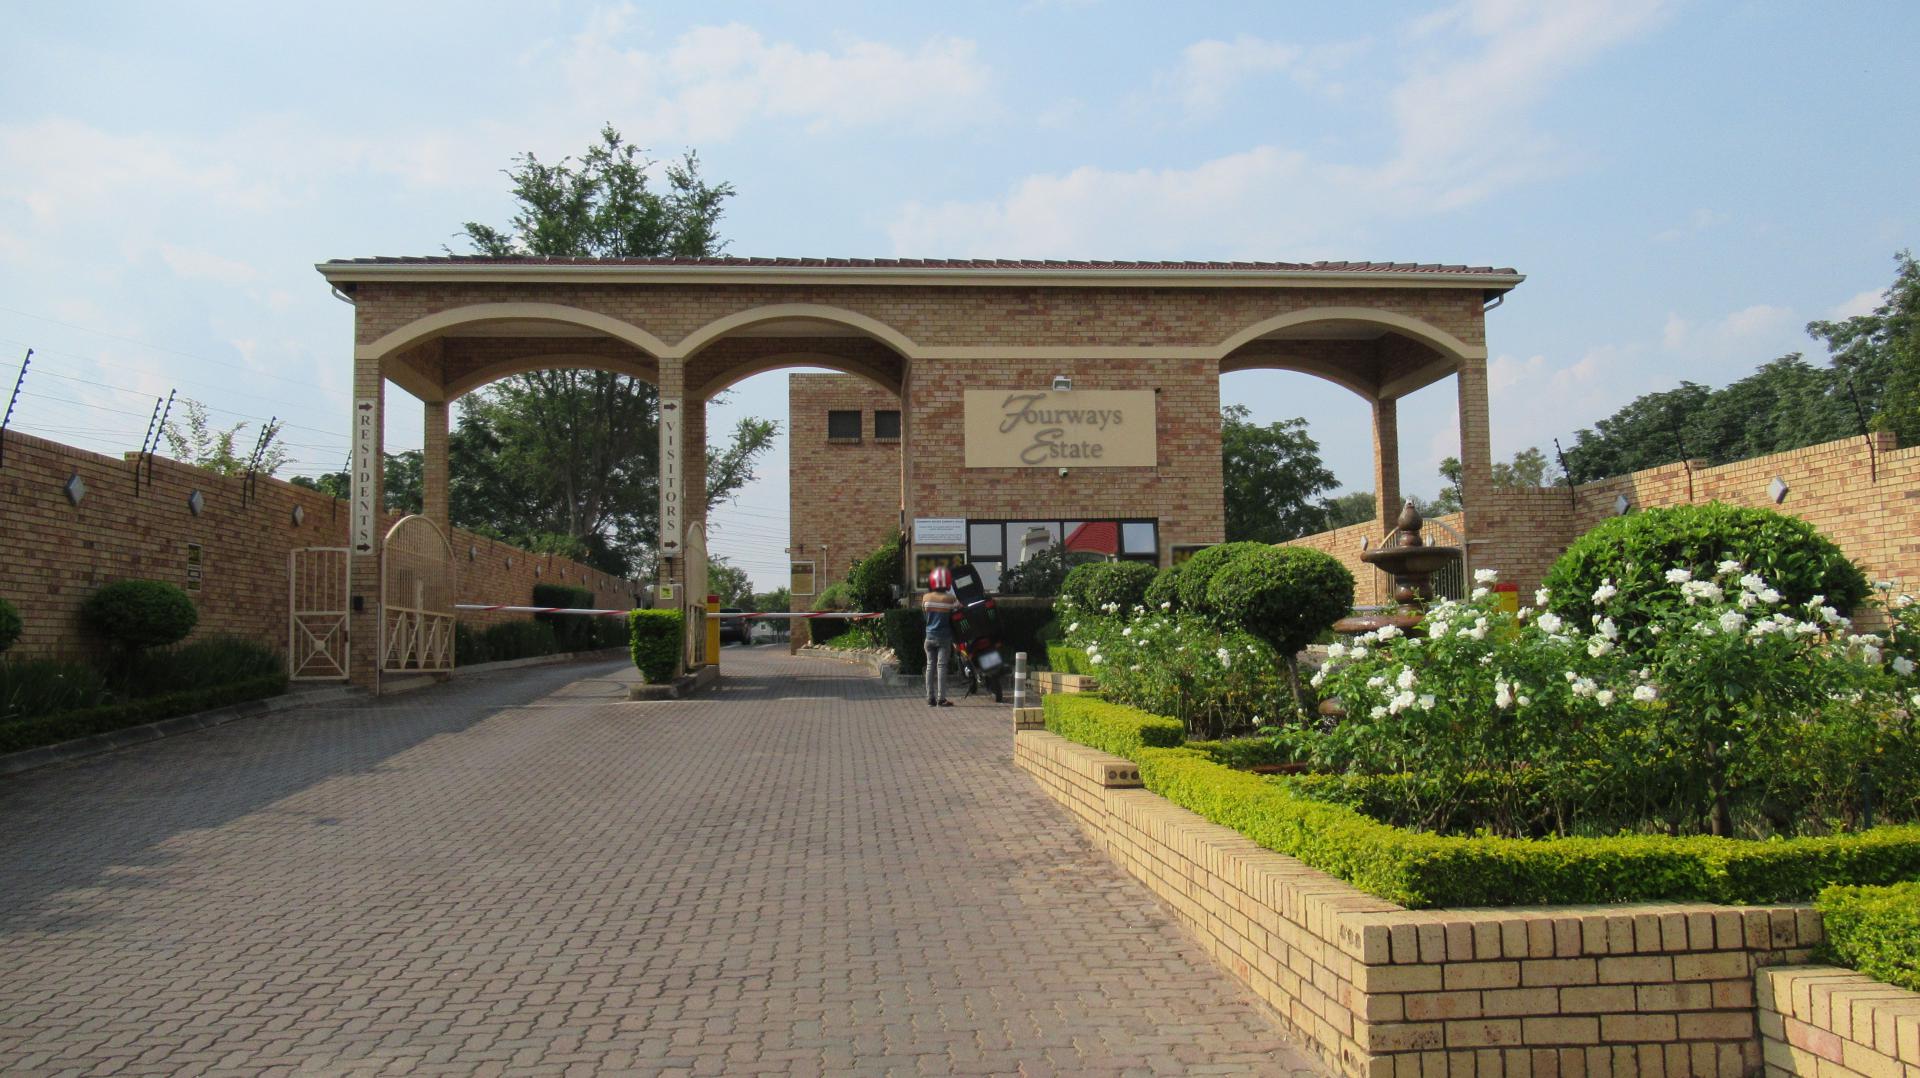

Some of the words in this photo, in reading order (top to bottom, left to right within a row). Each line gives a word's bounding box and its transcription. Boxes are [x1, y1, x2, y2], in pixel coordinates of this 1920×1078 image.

[1000, 393, 1122, 433] Fourways
[1020, 428, 1103, 465] Estate
[359, 415, 371, 541] RESIDENTS
[665, 421, 677, 531] VISITORS
